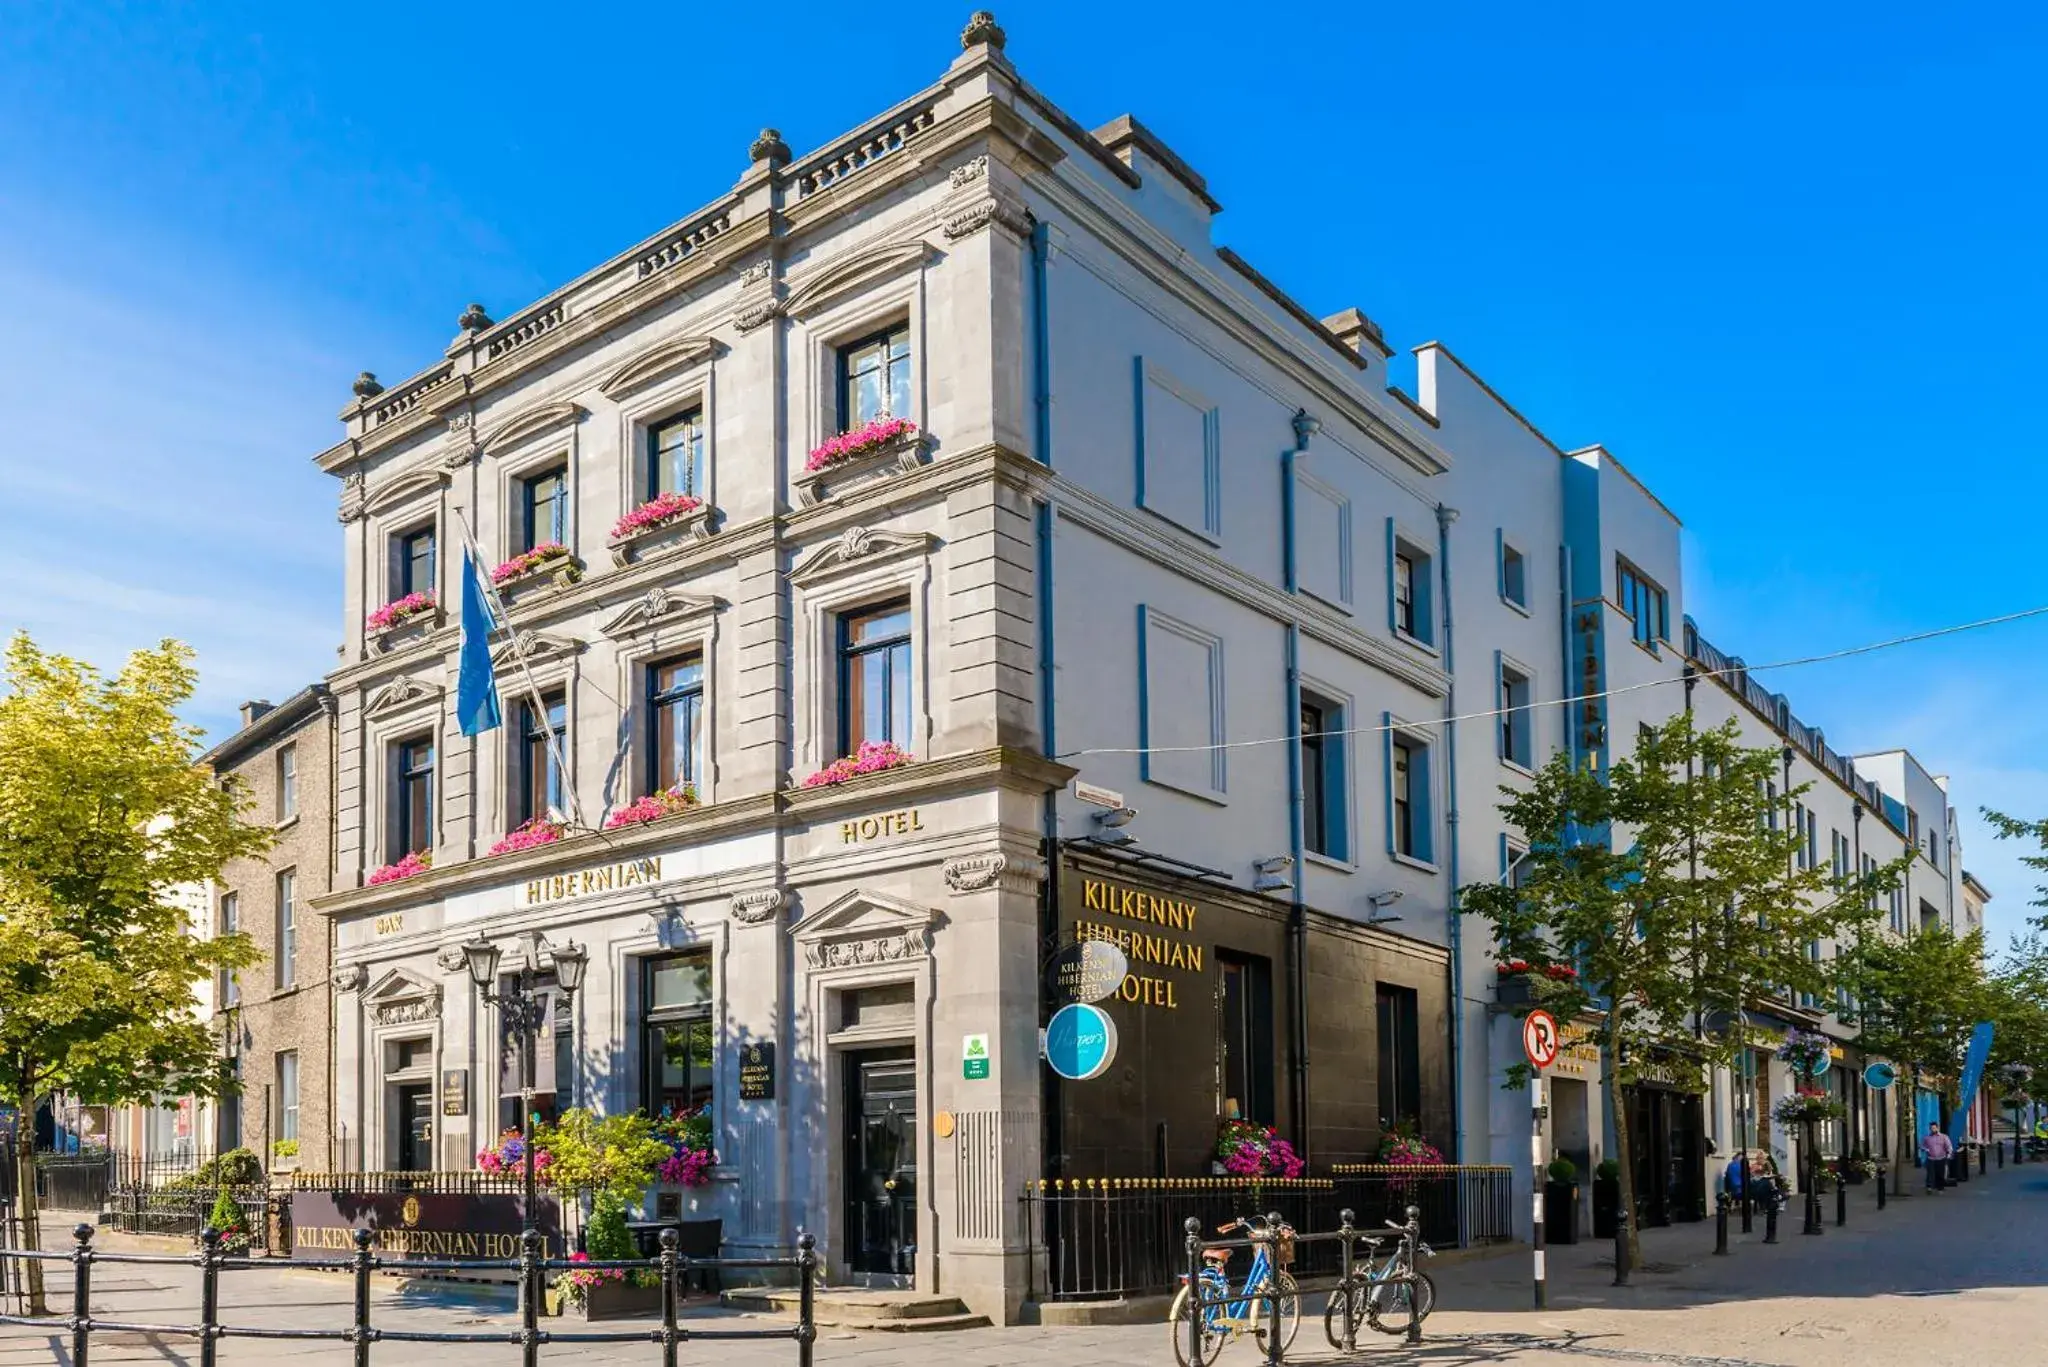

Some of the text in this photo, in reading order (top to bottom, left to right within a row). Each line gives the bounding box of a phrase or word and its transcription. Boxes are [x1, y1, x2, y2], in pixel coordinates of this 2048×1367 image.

[839, 810, 925, 844] HOTEL
[526, 856, 662, 905] HIBERNIAN
[1083, 878, 1197, 932] KILKENNY
[1069, 982, 1104, 997] HOTEL
[1114, 974, 1178, 1008] OTEL
[296, 1226, 556, 1261] KILKEN HIBERNIAN HOTL
